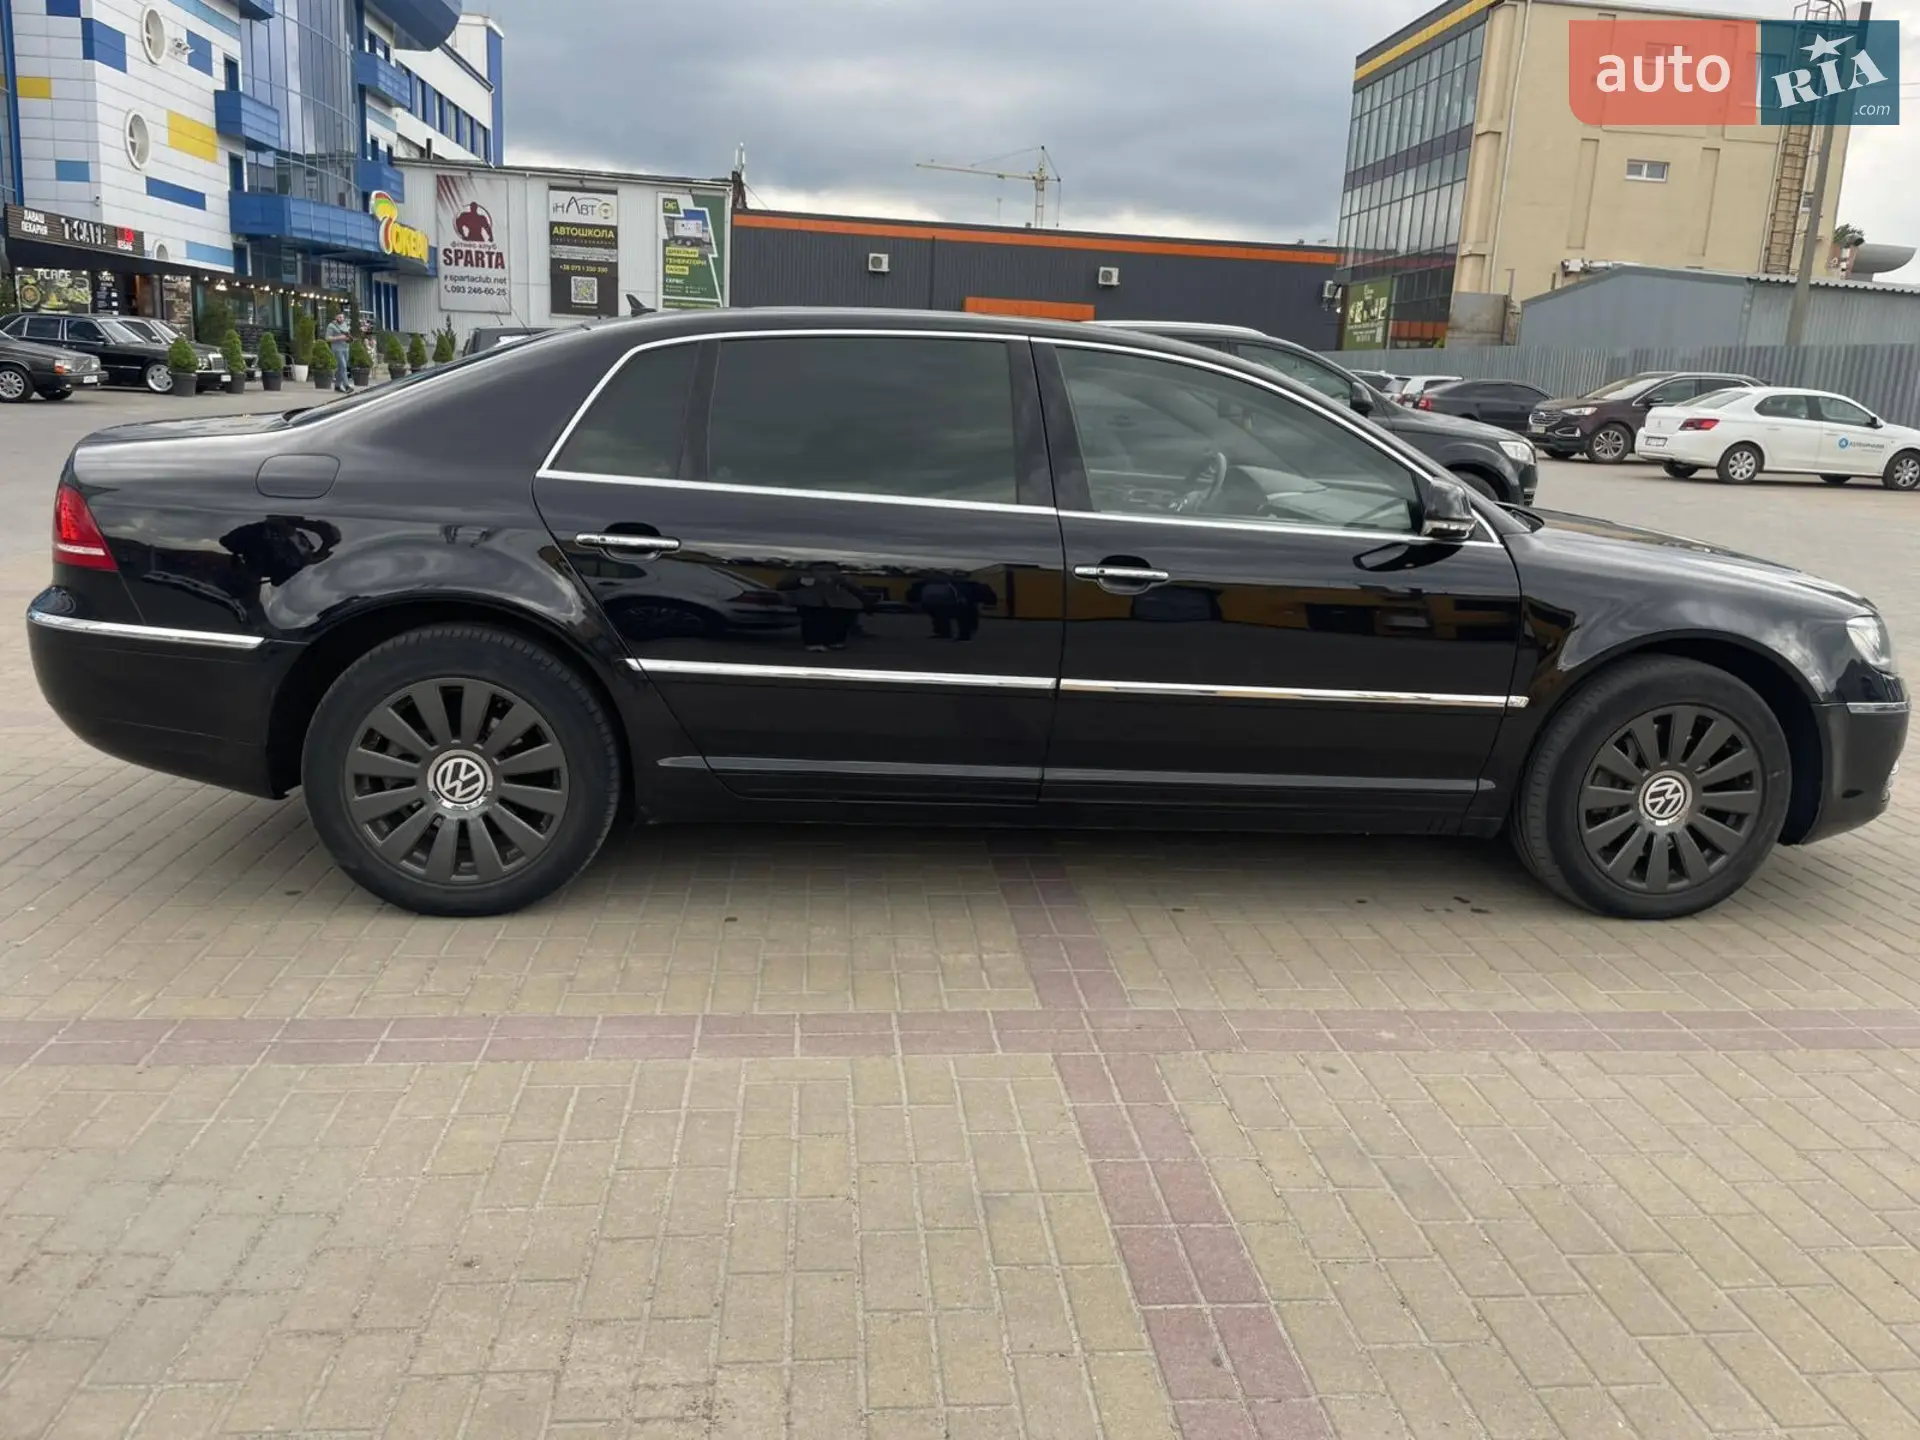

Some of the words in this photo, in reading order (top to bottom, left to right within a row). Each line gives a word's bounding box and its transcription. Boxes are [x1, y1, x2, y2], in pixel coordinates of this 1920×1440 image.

[552, 226, 615, 238] АВТОШКОЛА
[442, 247, 506, 270] SPARTA
[449, 274, 507, 284] spartaclub.net
